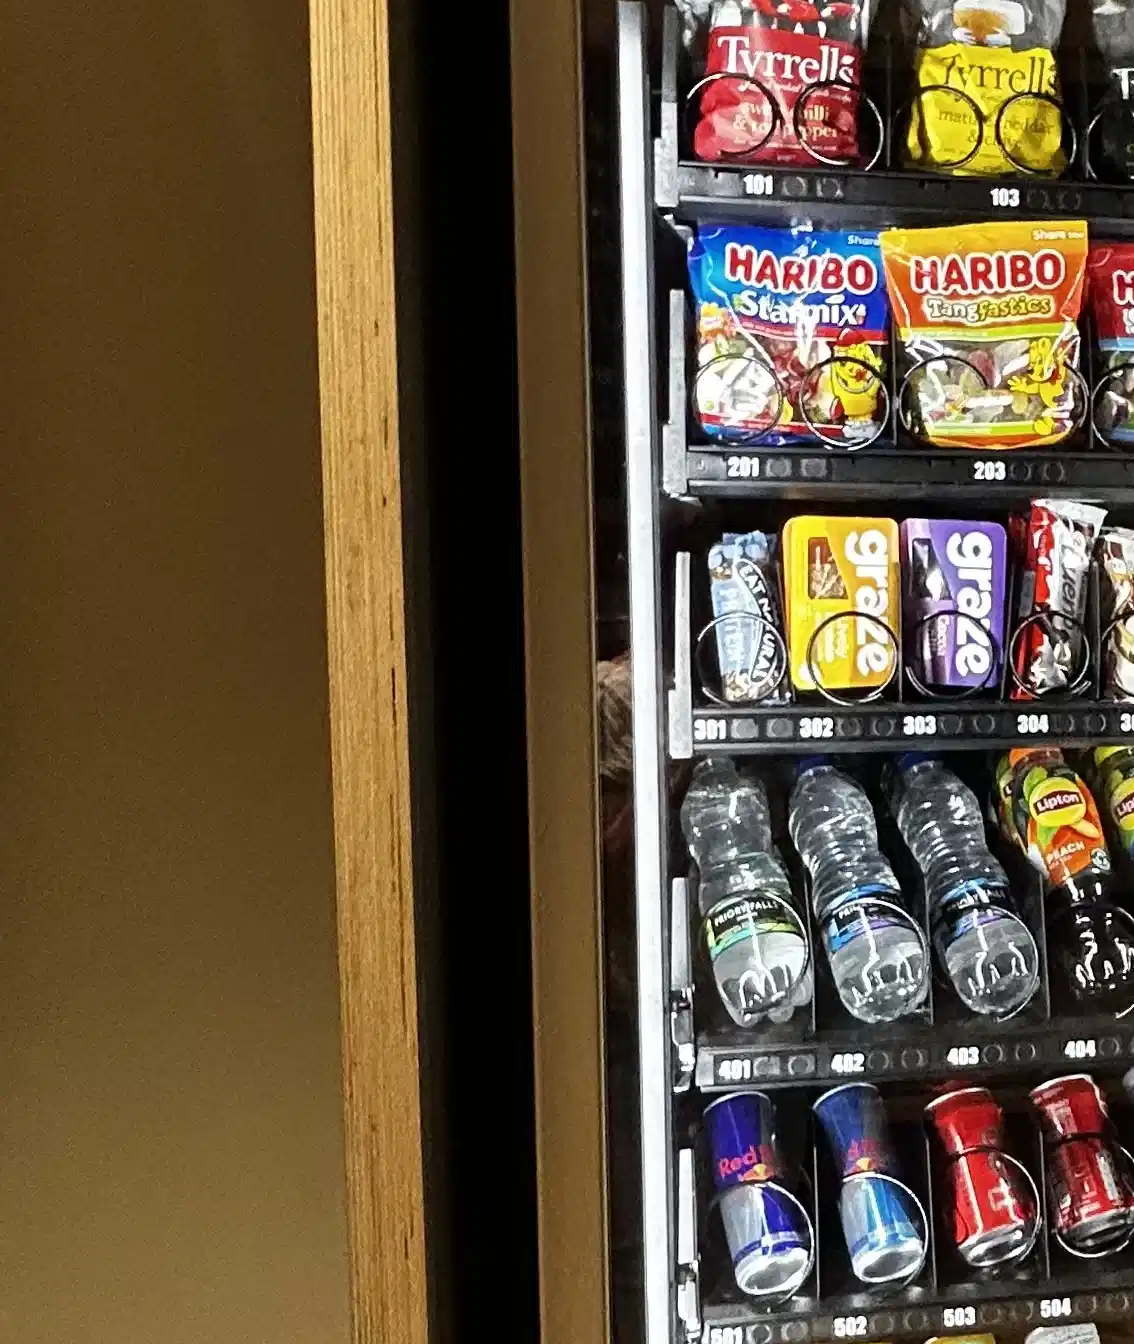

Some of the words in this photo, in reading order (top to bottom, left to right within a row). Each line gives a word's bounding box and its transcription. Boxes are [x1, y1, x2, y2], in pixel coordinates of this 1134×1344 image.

[717, 35, 855, 88] Tyrrells
[940, 55, 1057, 97] Tyrrells
[744, 174, 773, 196] 101
[990, 188, 1020, 208] 103
[728, 244, 875, 293] HARIBO
[913, 251, 1064, 292] HARIBO
[927, 297, 1052, 323] Tangfastics
[728, 459, 760, 477] 201
[974, 462, 1006, 480] 203
[739, 564, 766, 596] EAT
[845, 529, 889, 676] graze
[946, 531, 993, 676] graze
[752, 597, 777, 683] NAURAL
[695, 719, 726, 739] 301
[800, 717, 834, 737] 302
[903, 715, 937, 735] 303
[1017, 714, 1049, 733] 304
[1037, 792, 1080, 812] Lipton
[947, 1046, 979, 1066] 403
[1065, 1039, 1096, 1058] 404
[719, 1059, 751, 1079] 401
[831, 1053, 864, 1073] 402
[719, 1145, 758, 1181] Red
[943, 1307, 976, 1327] 503
[1040, 1299, 1071, 1319] 504
[833, 1316, 867, 1336] 502
